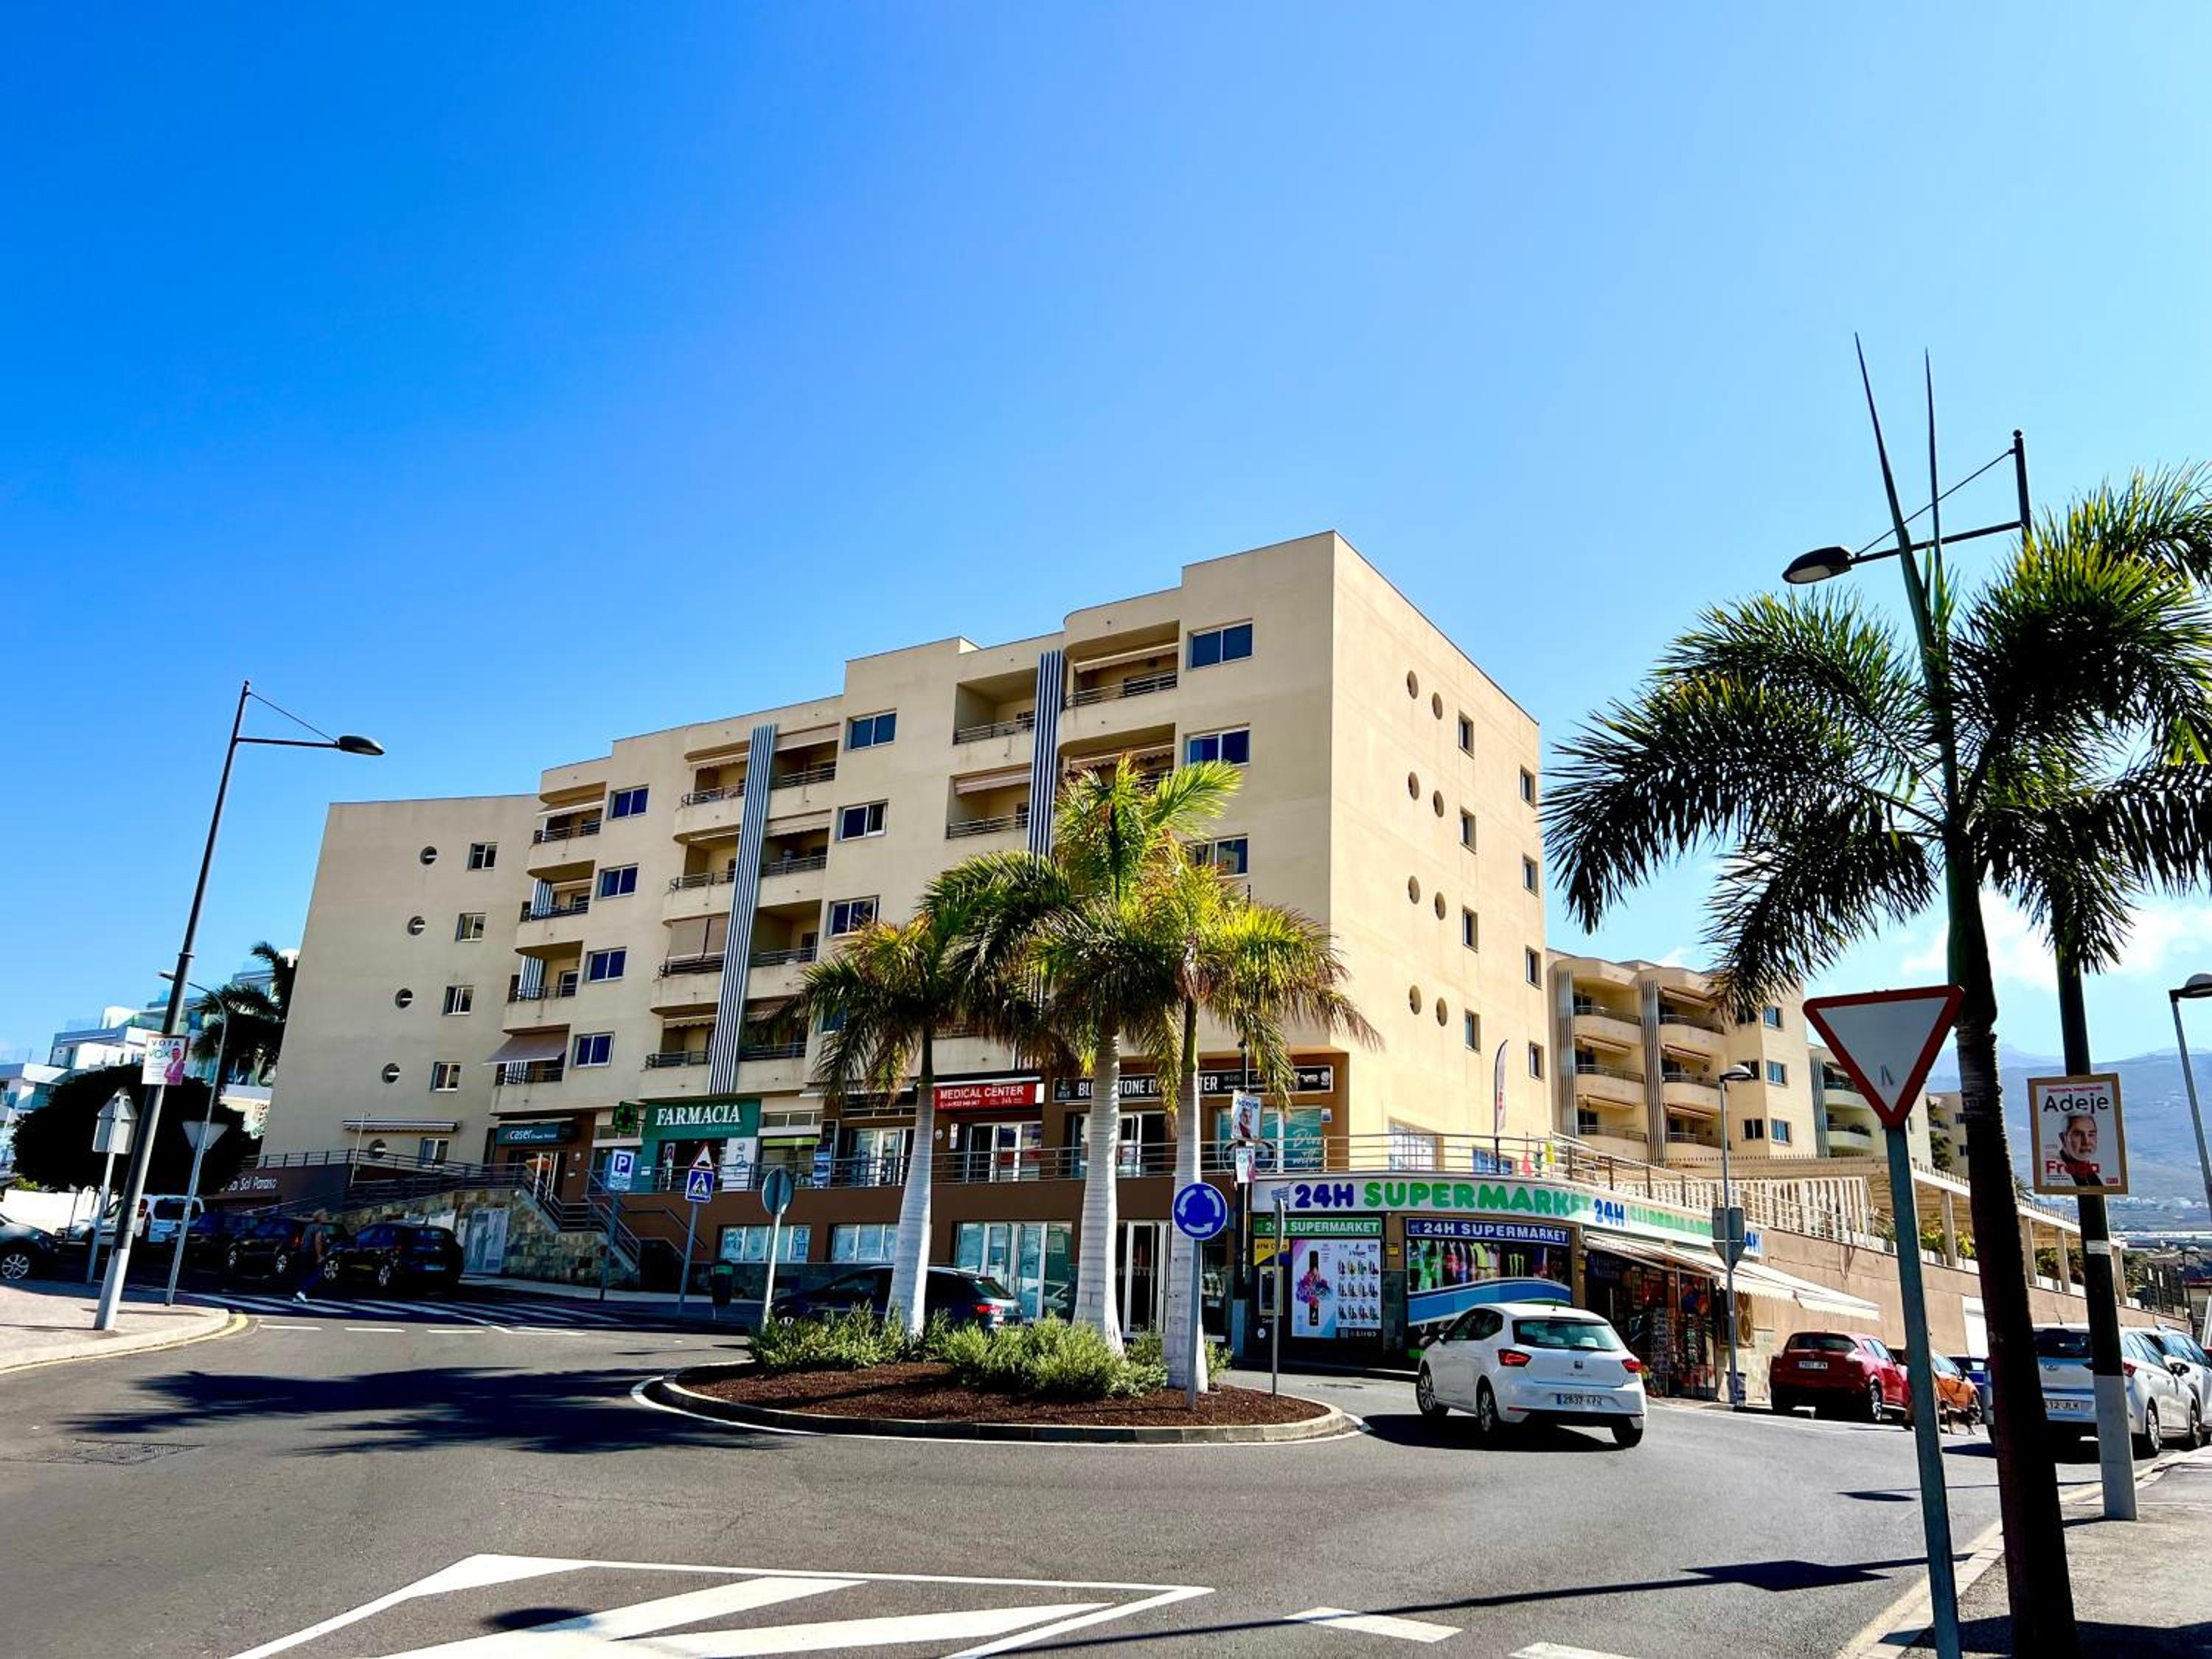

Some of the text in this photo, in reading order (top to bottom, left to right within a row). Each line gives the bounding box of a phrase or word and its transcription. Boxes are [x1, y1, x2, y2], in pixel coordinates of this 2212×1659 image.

[148, 1048, 170, 1060] VOX
[940, 1085, 1024, 1099] MEDICAL CENTER
[2043, 1093, 2109, 1114] Adeje
[655, 1105, 741, 1126] FARMACIA
[617, 1155, 628, 1171] P
[1295, 1182, 1593, 1217] 24H SUPERMARKET
[1593, 1198, 1624, 1227] 24H
[1291, 1222, 1379, 1232] SUPERMARKET
[1424, 1222, 1567, 1242] 24H SUPERMARKET
